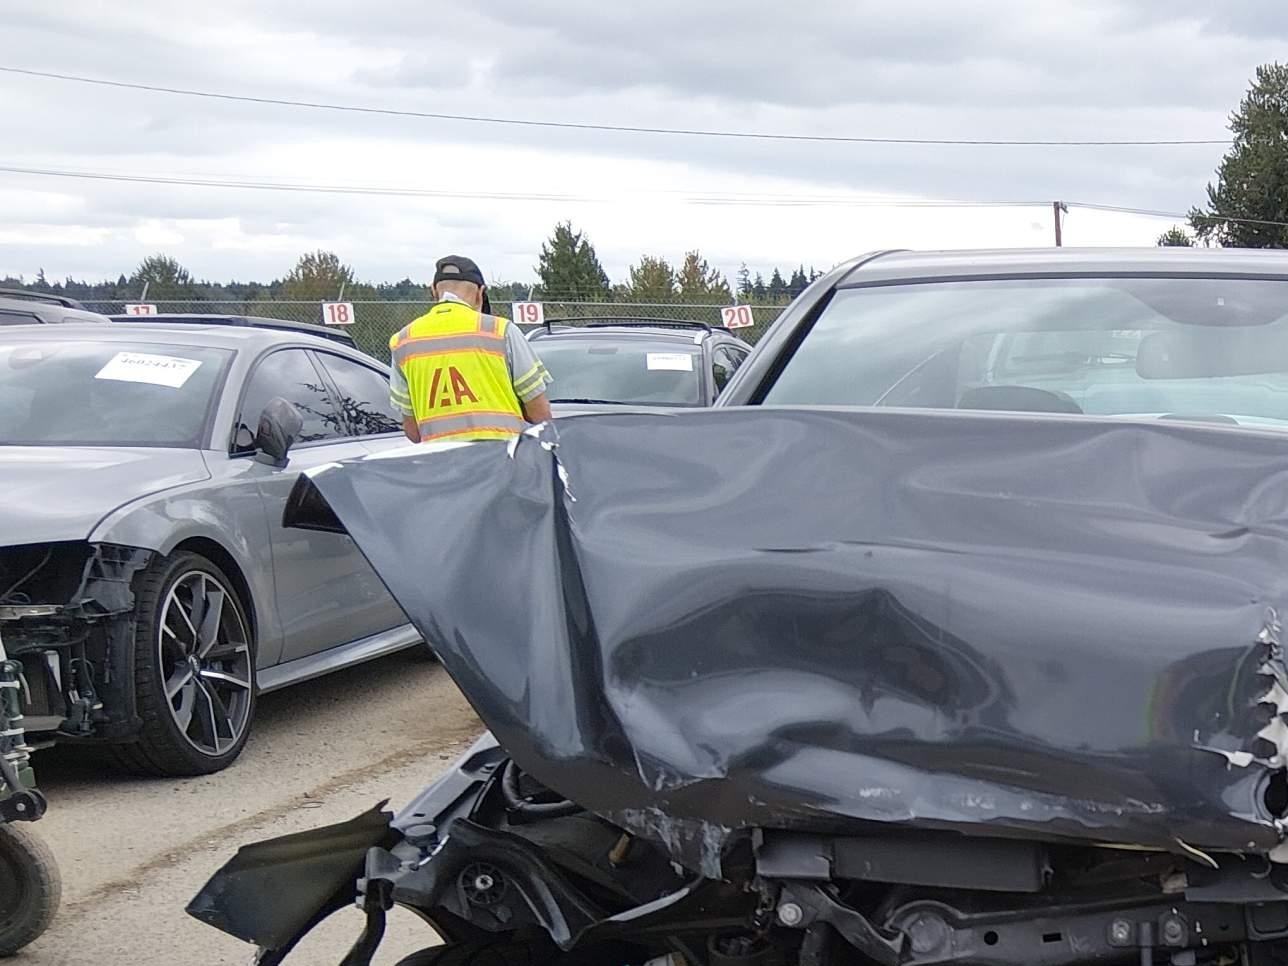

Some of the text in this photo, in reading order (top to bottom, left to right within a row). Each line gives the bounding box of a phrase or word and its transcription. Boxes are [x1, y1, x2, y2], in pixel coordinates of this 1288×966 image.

[328, 304, 349, 322] 18
[518, 304, 539, 322] 19
[725, 307, 750, 327] 20
